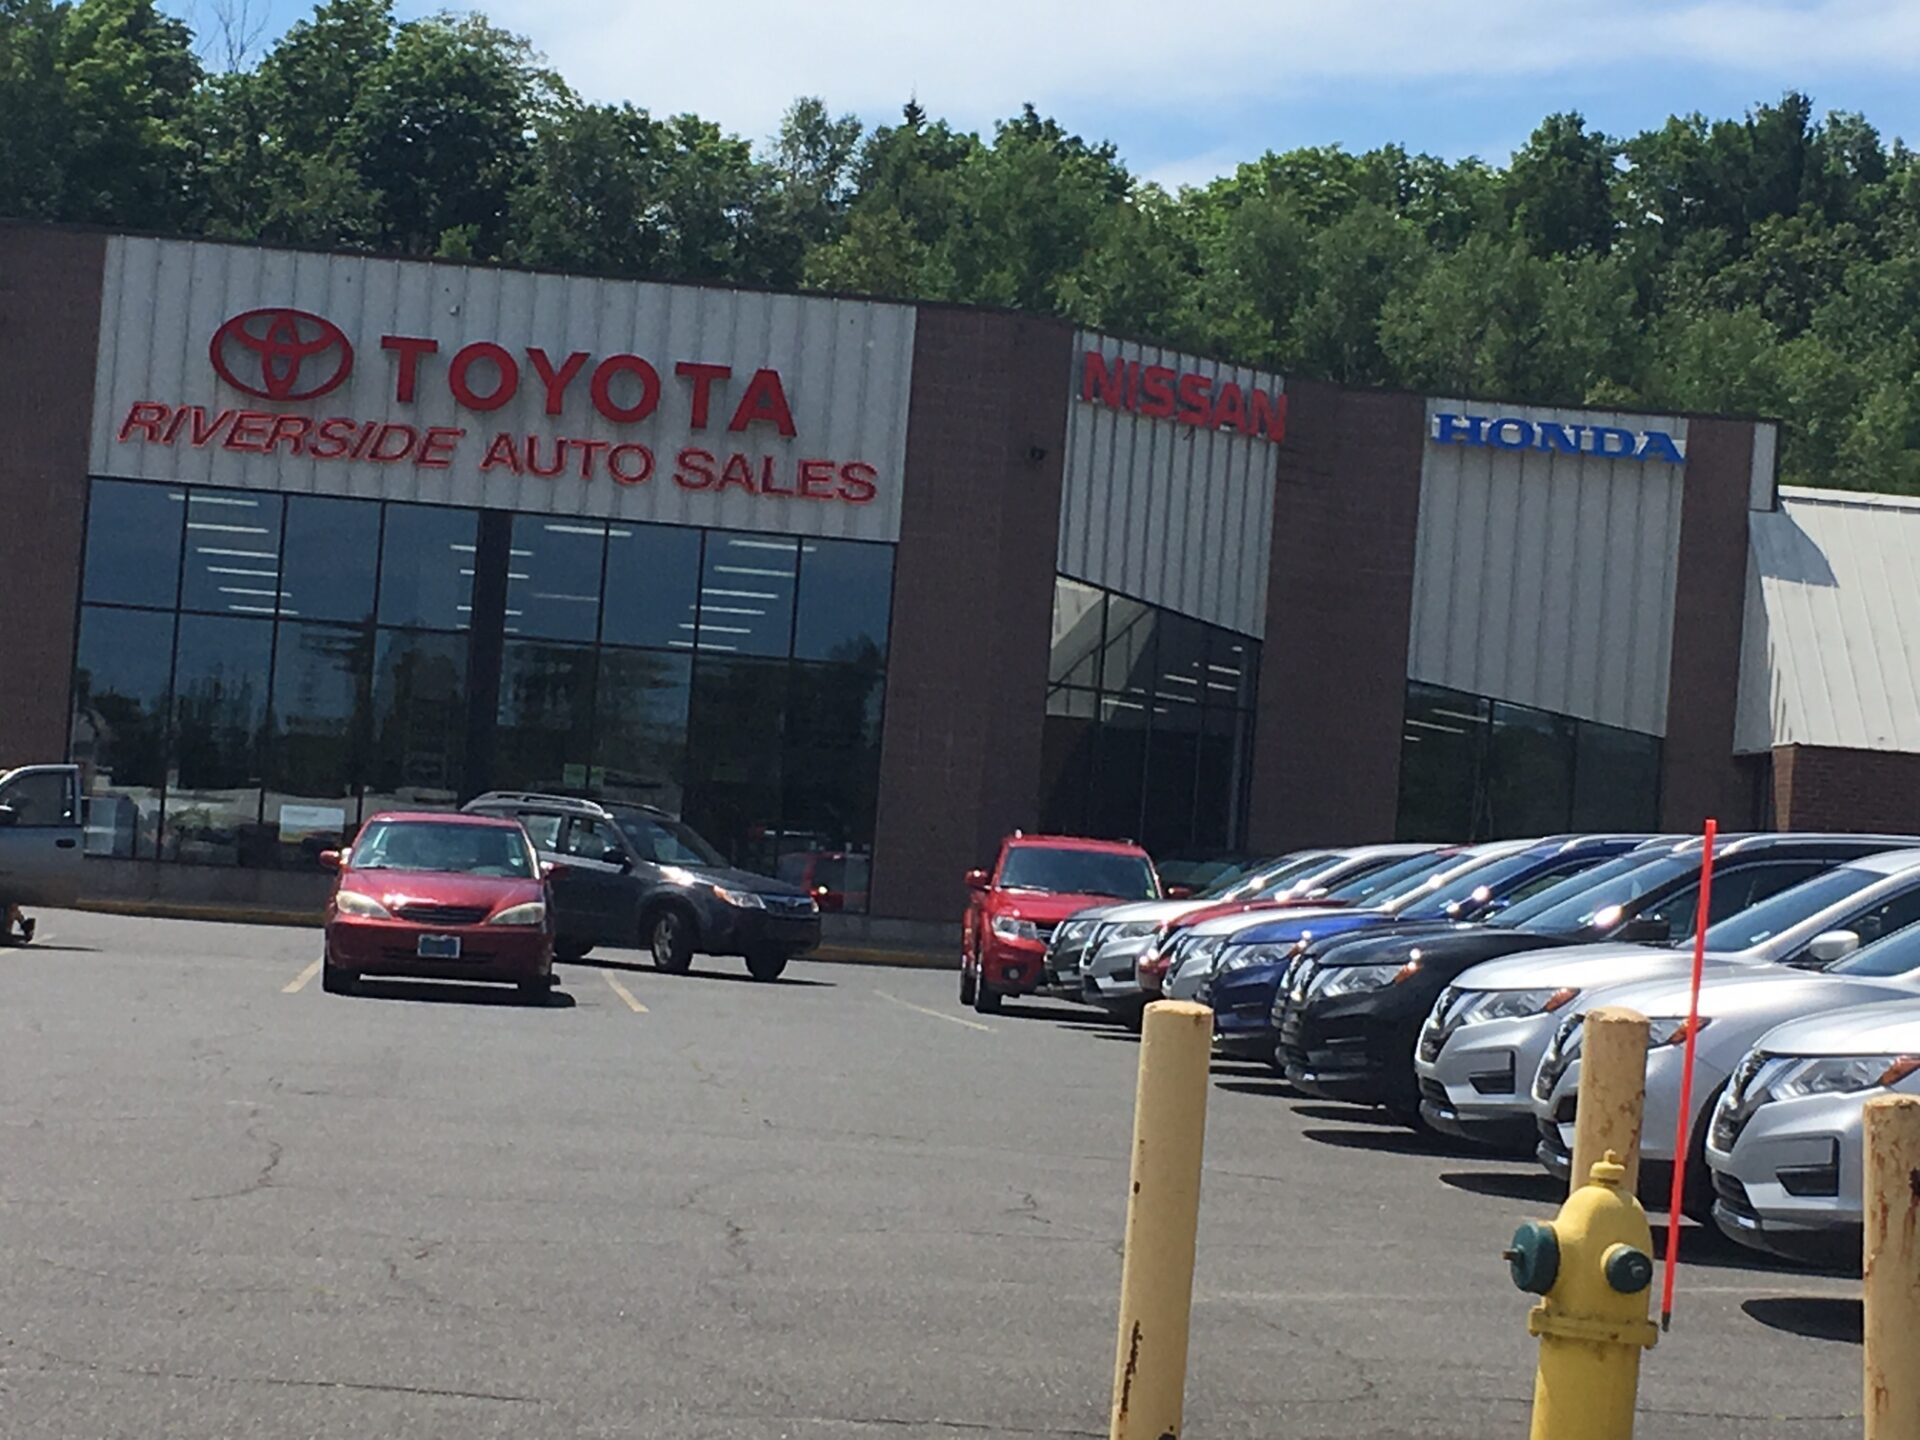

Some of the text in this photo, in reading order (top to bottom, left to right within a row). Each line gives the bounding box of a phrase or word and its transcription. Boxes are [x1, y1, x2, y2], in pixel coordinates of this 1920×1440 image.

[381, 335, 797, 438] TOYOTA
[1082, 350, 1288, 443] NISSAN
[117, 401, 879, 506] RIVERSIDE AUTO SALES
[1431, 412, 1687, 464] HONDA
